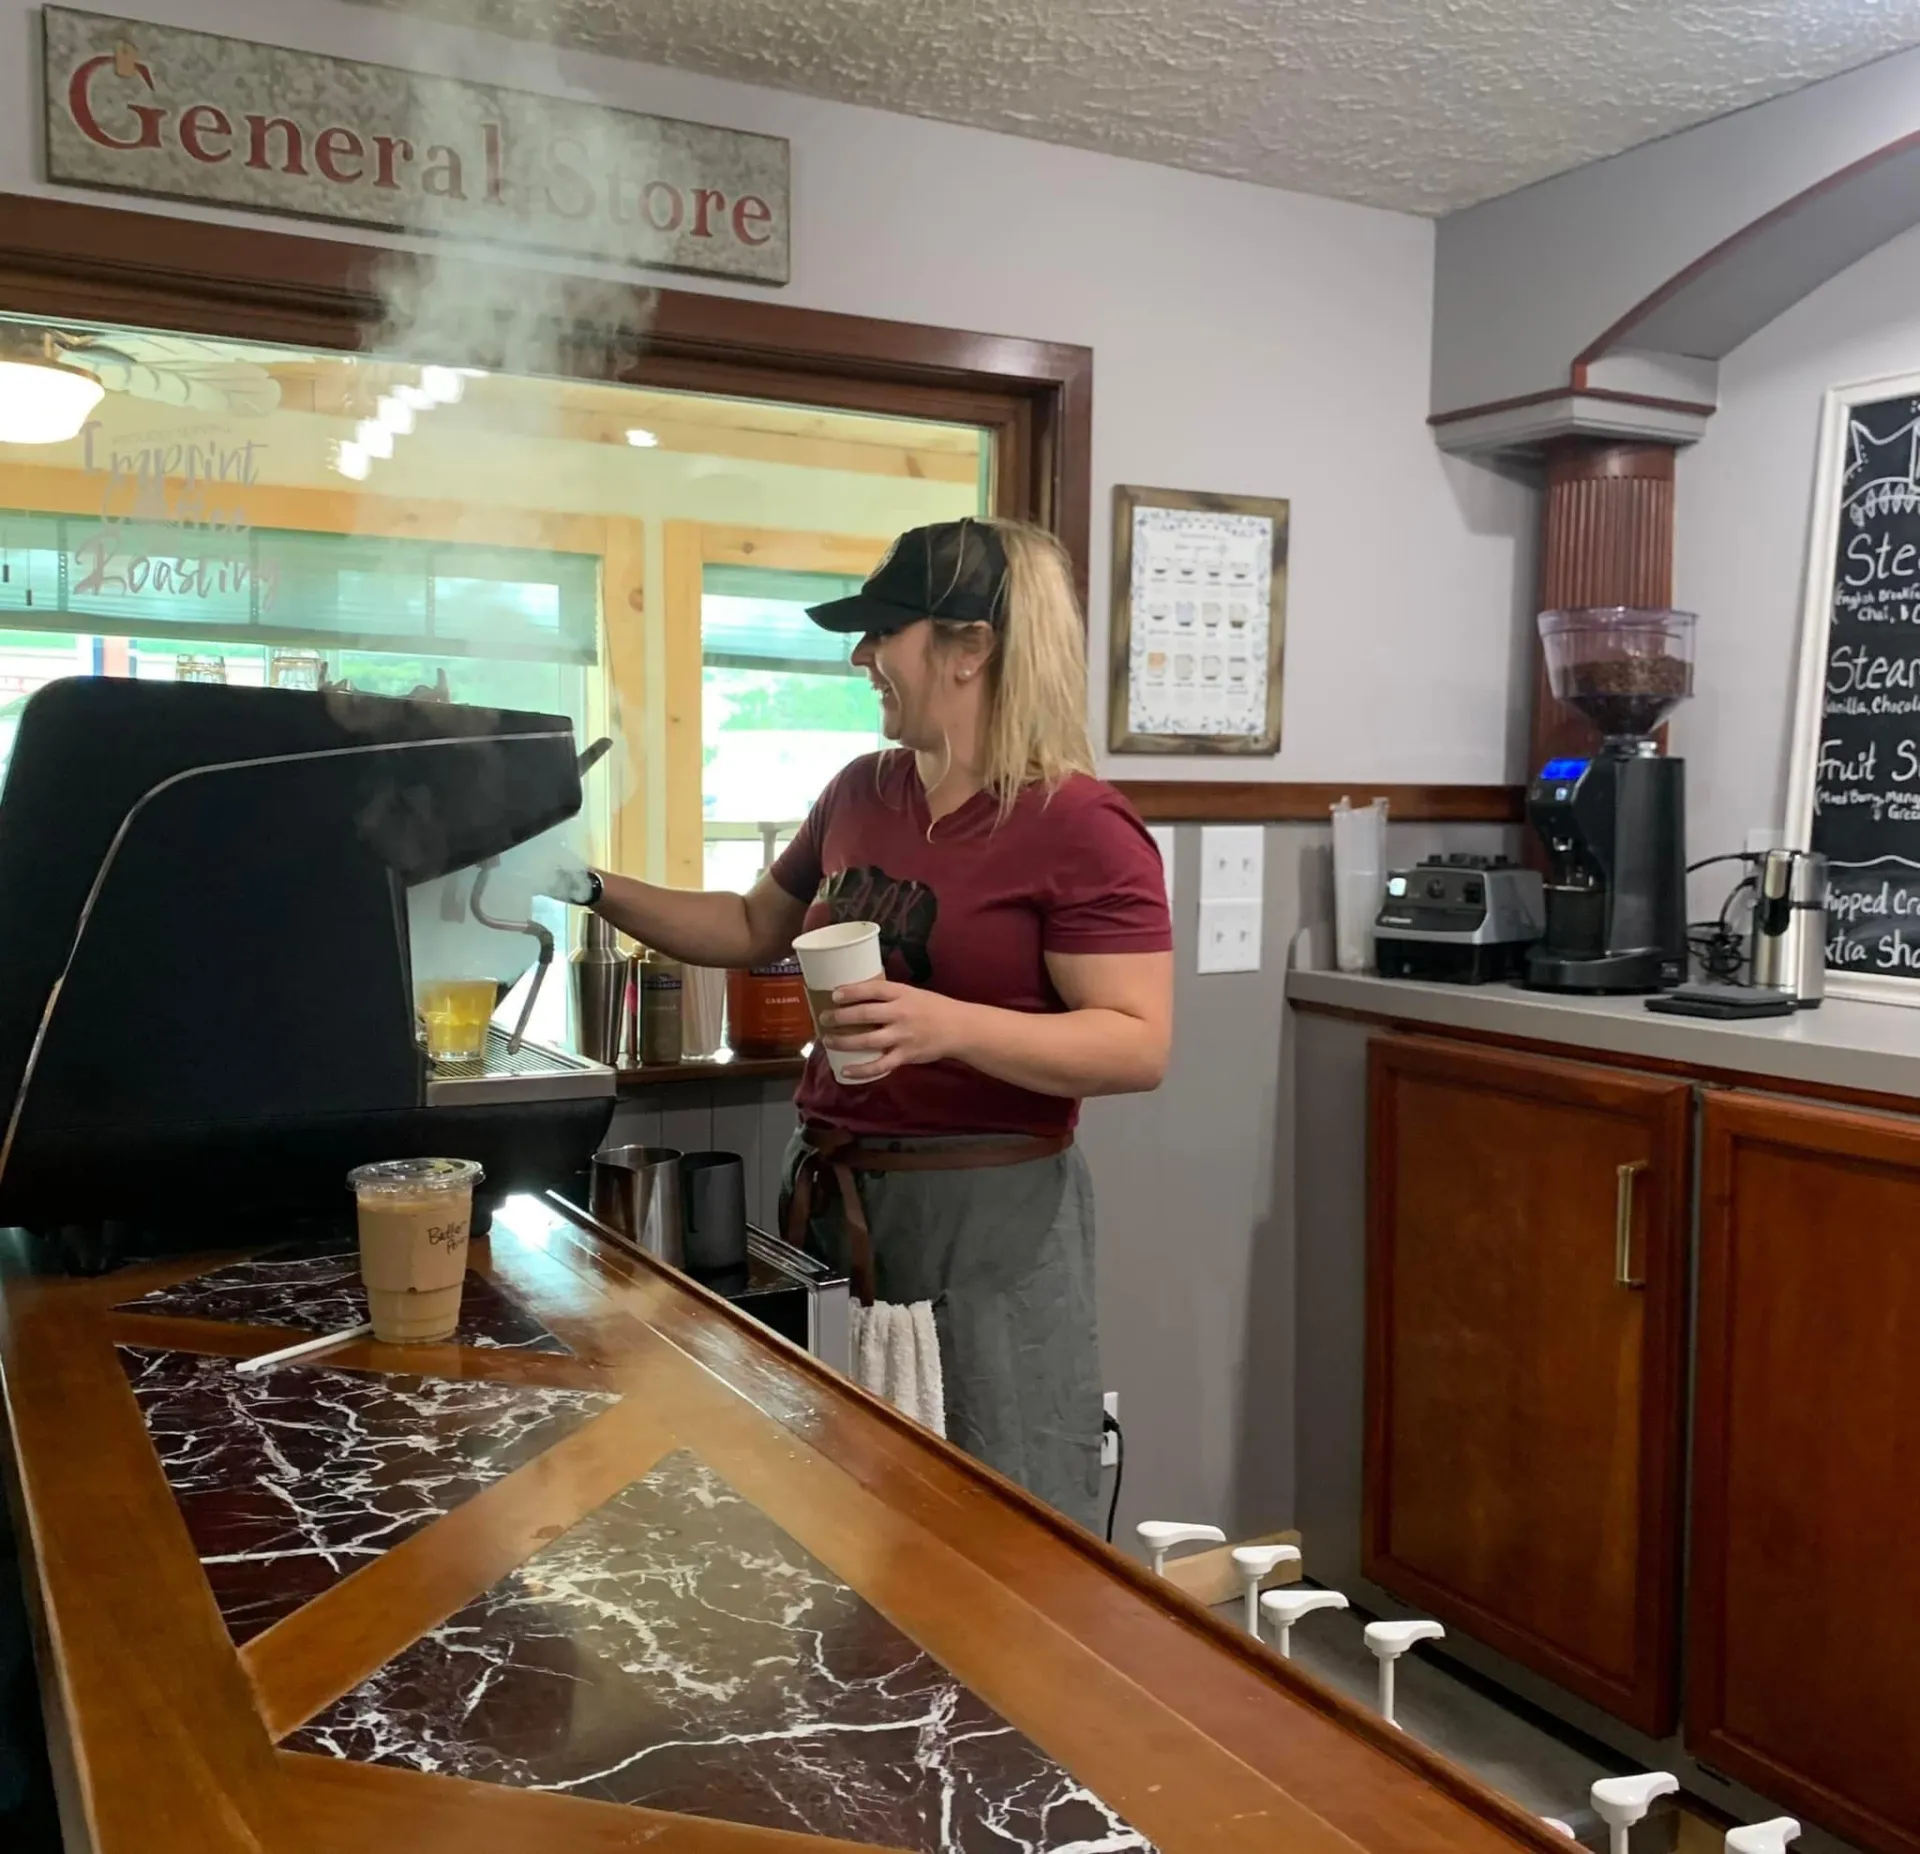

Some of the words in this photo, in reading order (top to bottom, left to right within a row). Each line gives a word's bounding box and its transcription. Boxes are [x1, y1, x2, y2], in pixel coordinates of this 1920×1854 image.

[68, 54, 509, 206] General
[543, 136, 774, 247] Store
[79, 419, 269, 492] Imprint
[73, 529, 281, 611] Roasting
[1844, 531, 1920, 586] Ste
[1817, 738, 1876, 781] Fruit
[1891, 739, 1920, 781] S
[1823, 881, 1889, 922] hipped
[1824, 928, 1867, 965] xtra
